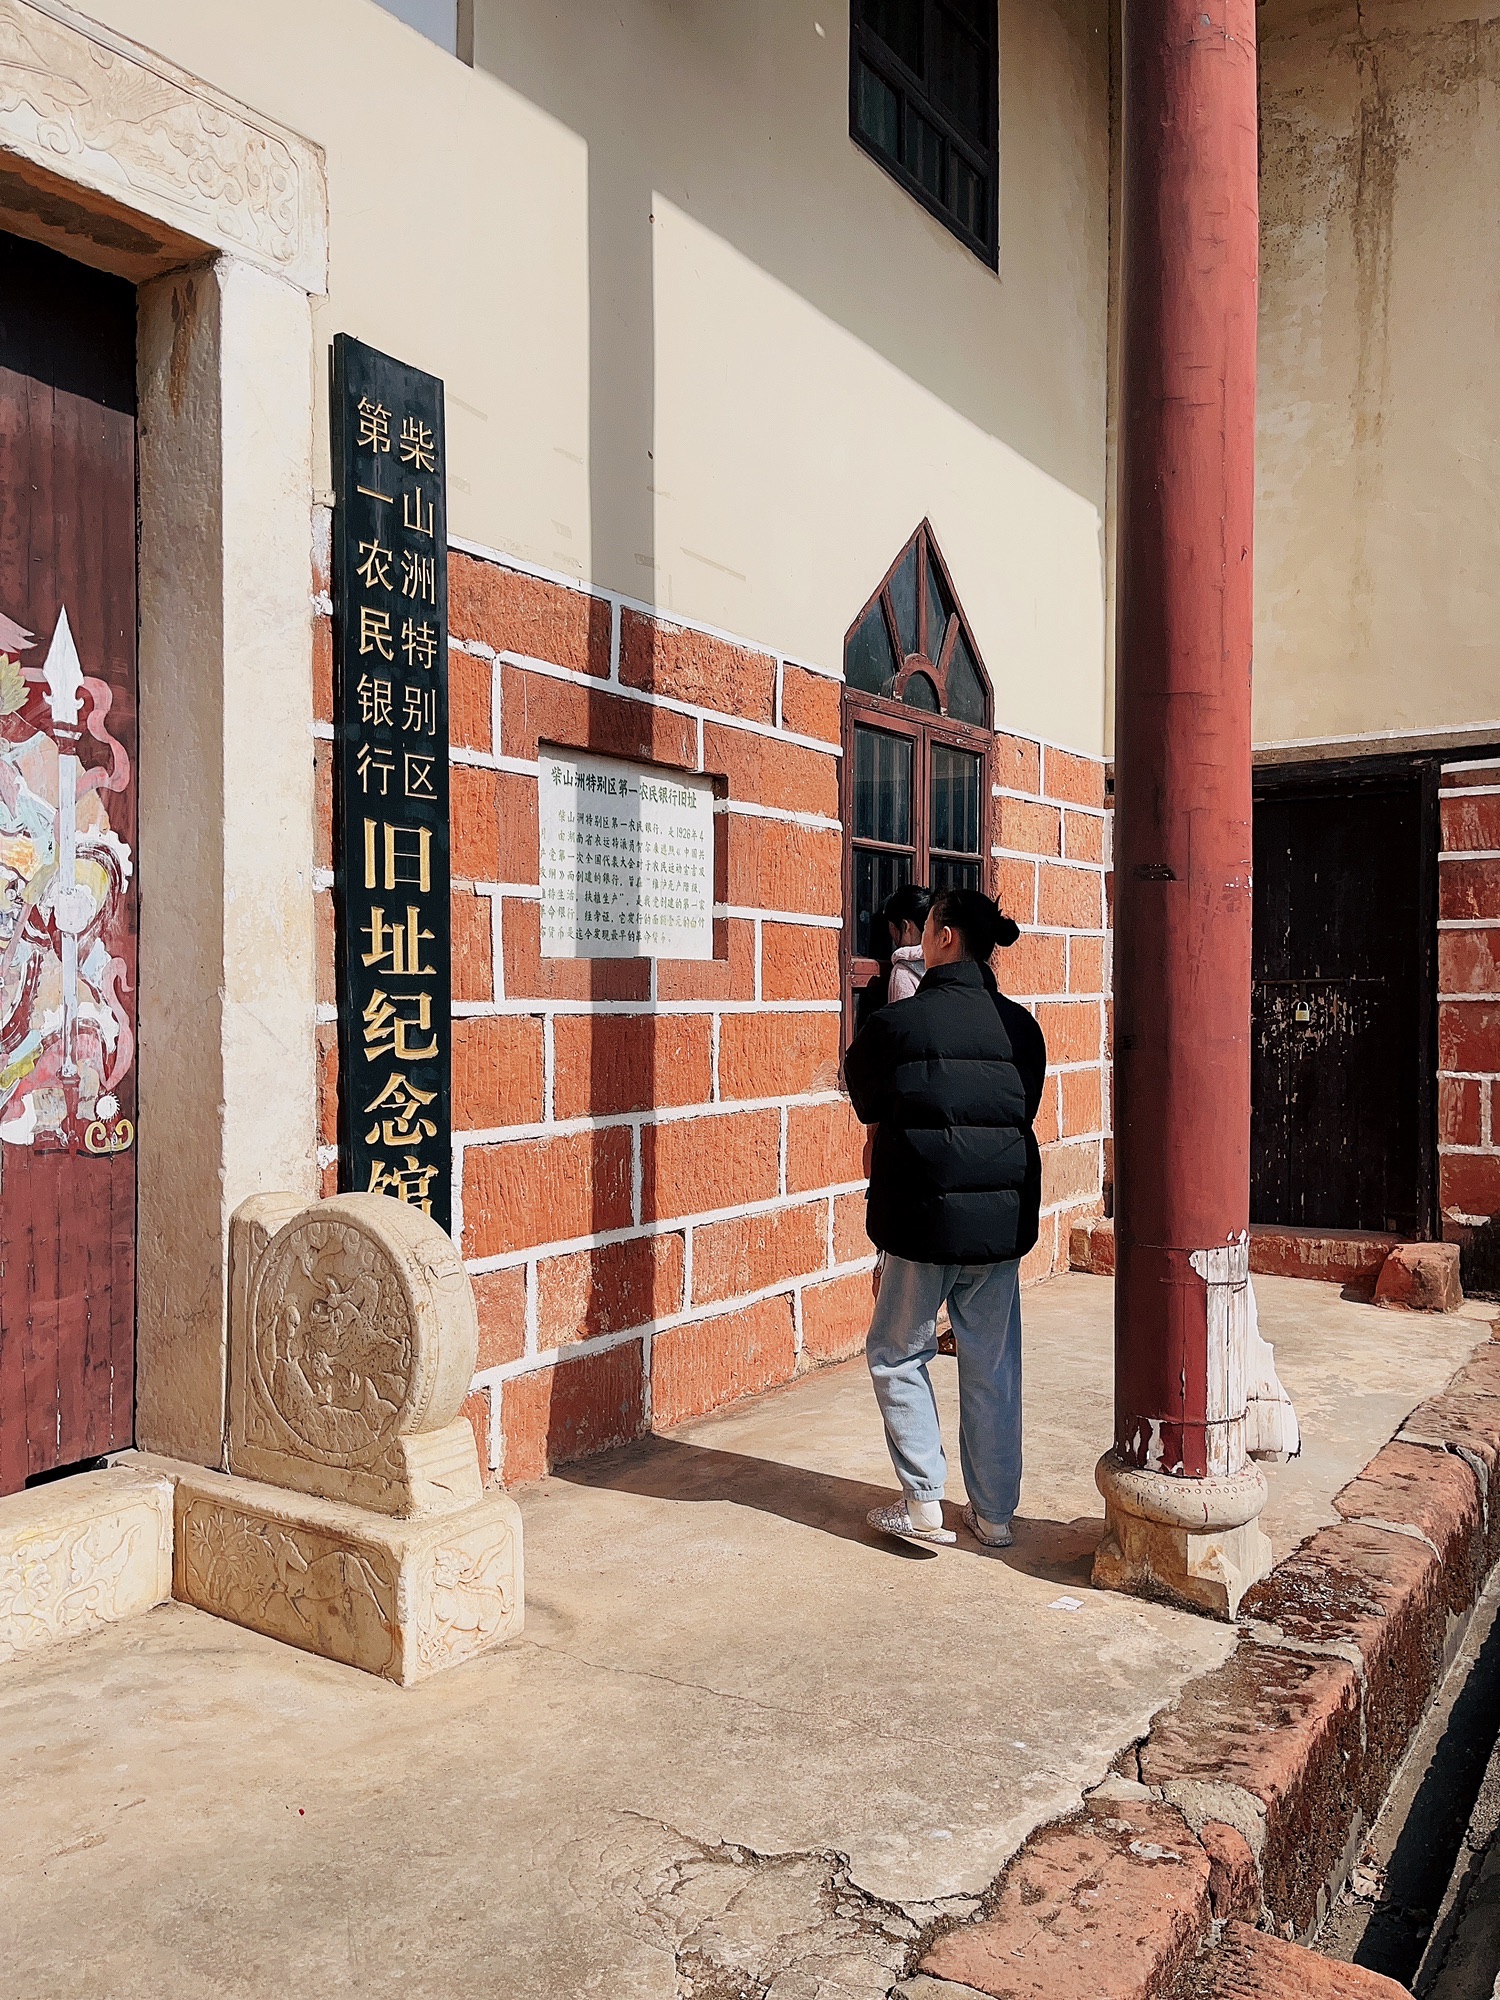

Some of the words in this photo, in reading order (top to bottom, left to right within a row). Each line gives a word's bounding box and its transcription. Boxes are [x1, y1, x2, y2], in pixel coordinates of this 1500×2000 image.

[356, 396, 396, 798] 第一农民银行
[399, 415, 438, 800] 柴山洲特别区
[550, 766, 698, 809] 柴山洲特别区第一农民银行旧址
[359, 817, 440, 1214] 旧址纪念馆
